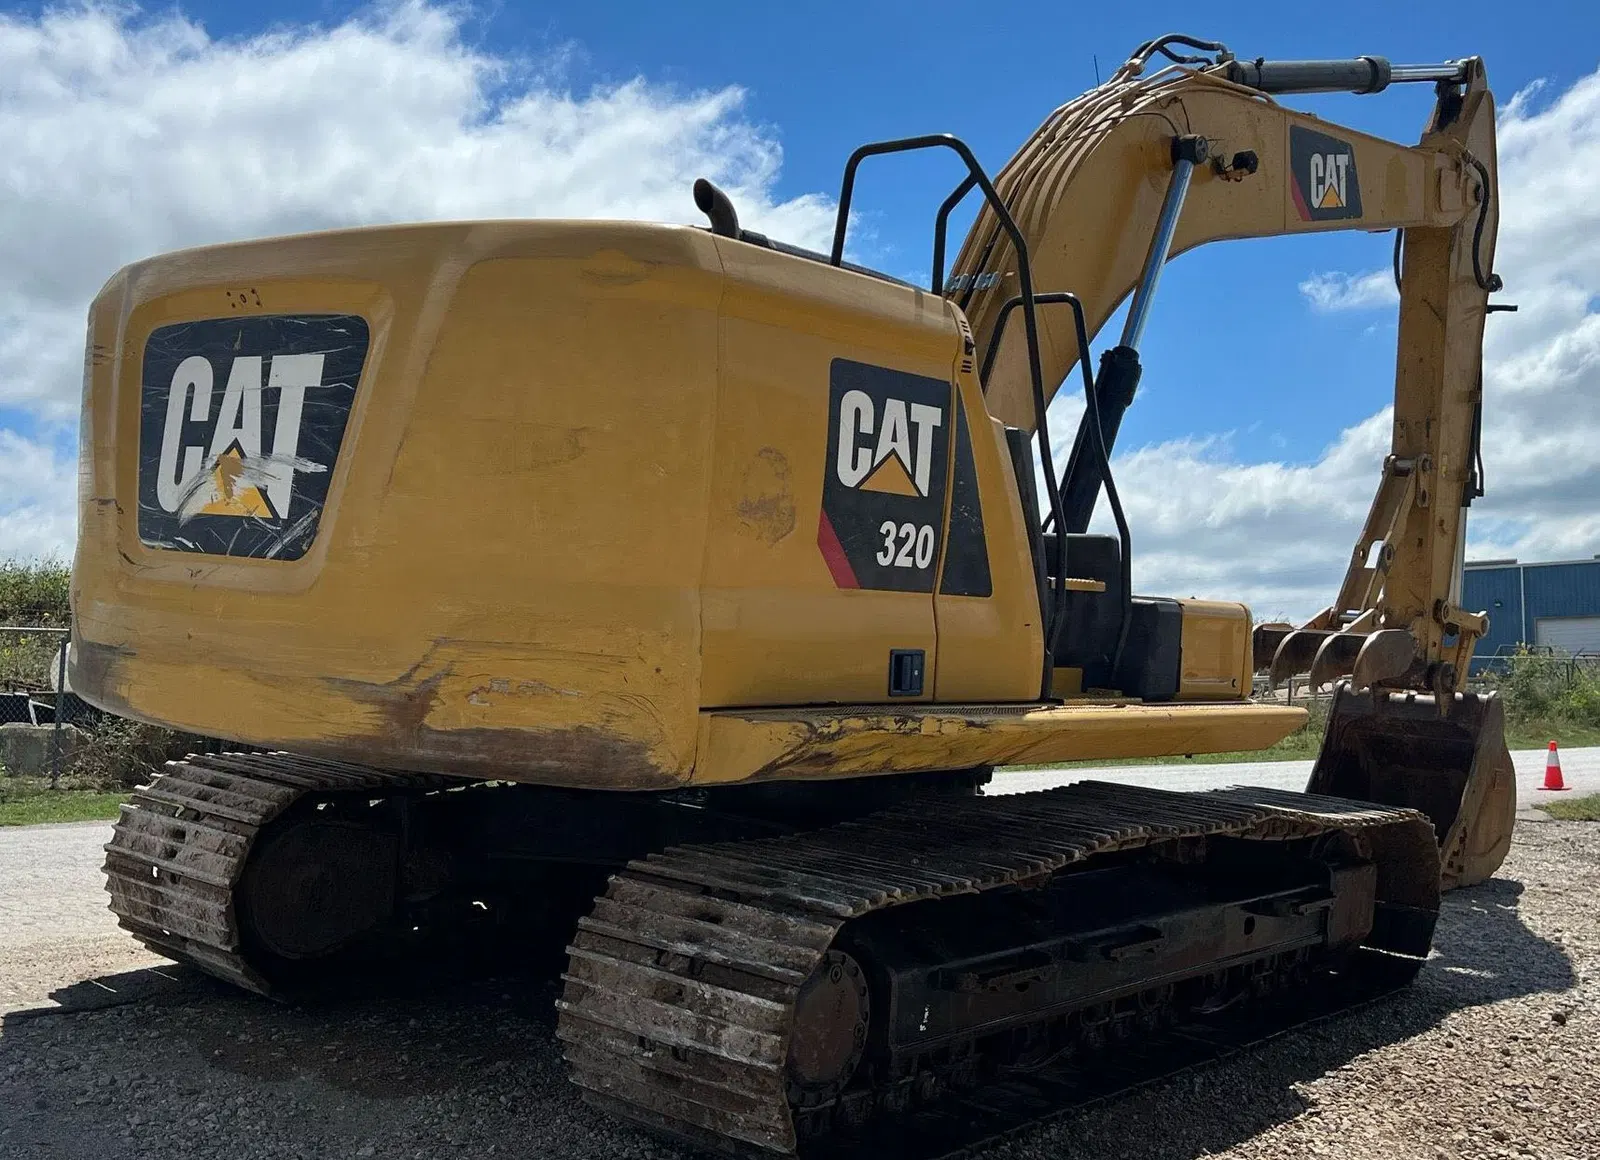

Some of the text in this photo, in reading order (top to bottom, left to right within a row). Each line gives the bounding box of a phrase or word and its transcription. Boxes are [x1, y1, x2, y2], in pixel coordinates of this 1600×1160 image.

[1310, 153, 1348, 208] CAT
[157, 354, 325, 520] CAT
[837, 389, 942, 498] CAT
[876, 520, 935, 569] 320
